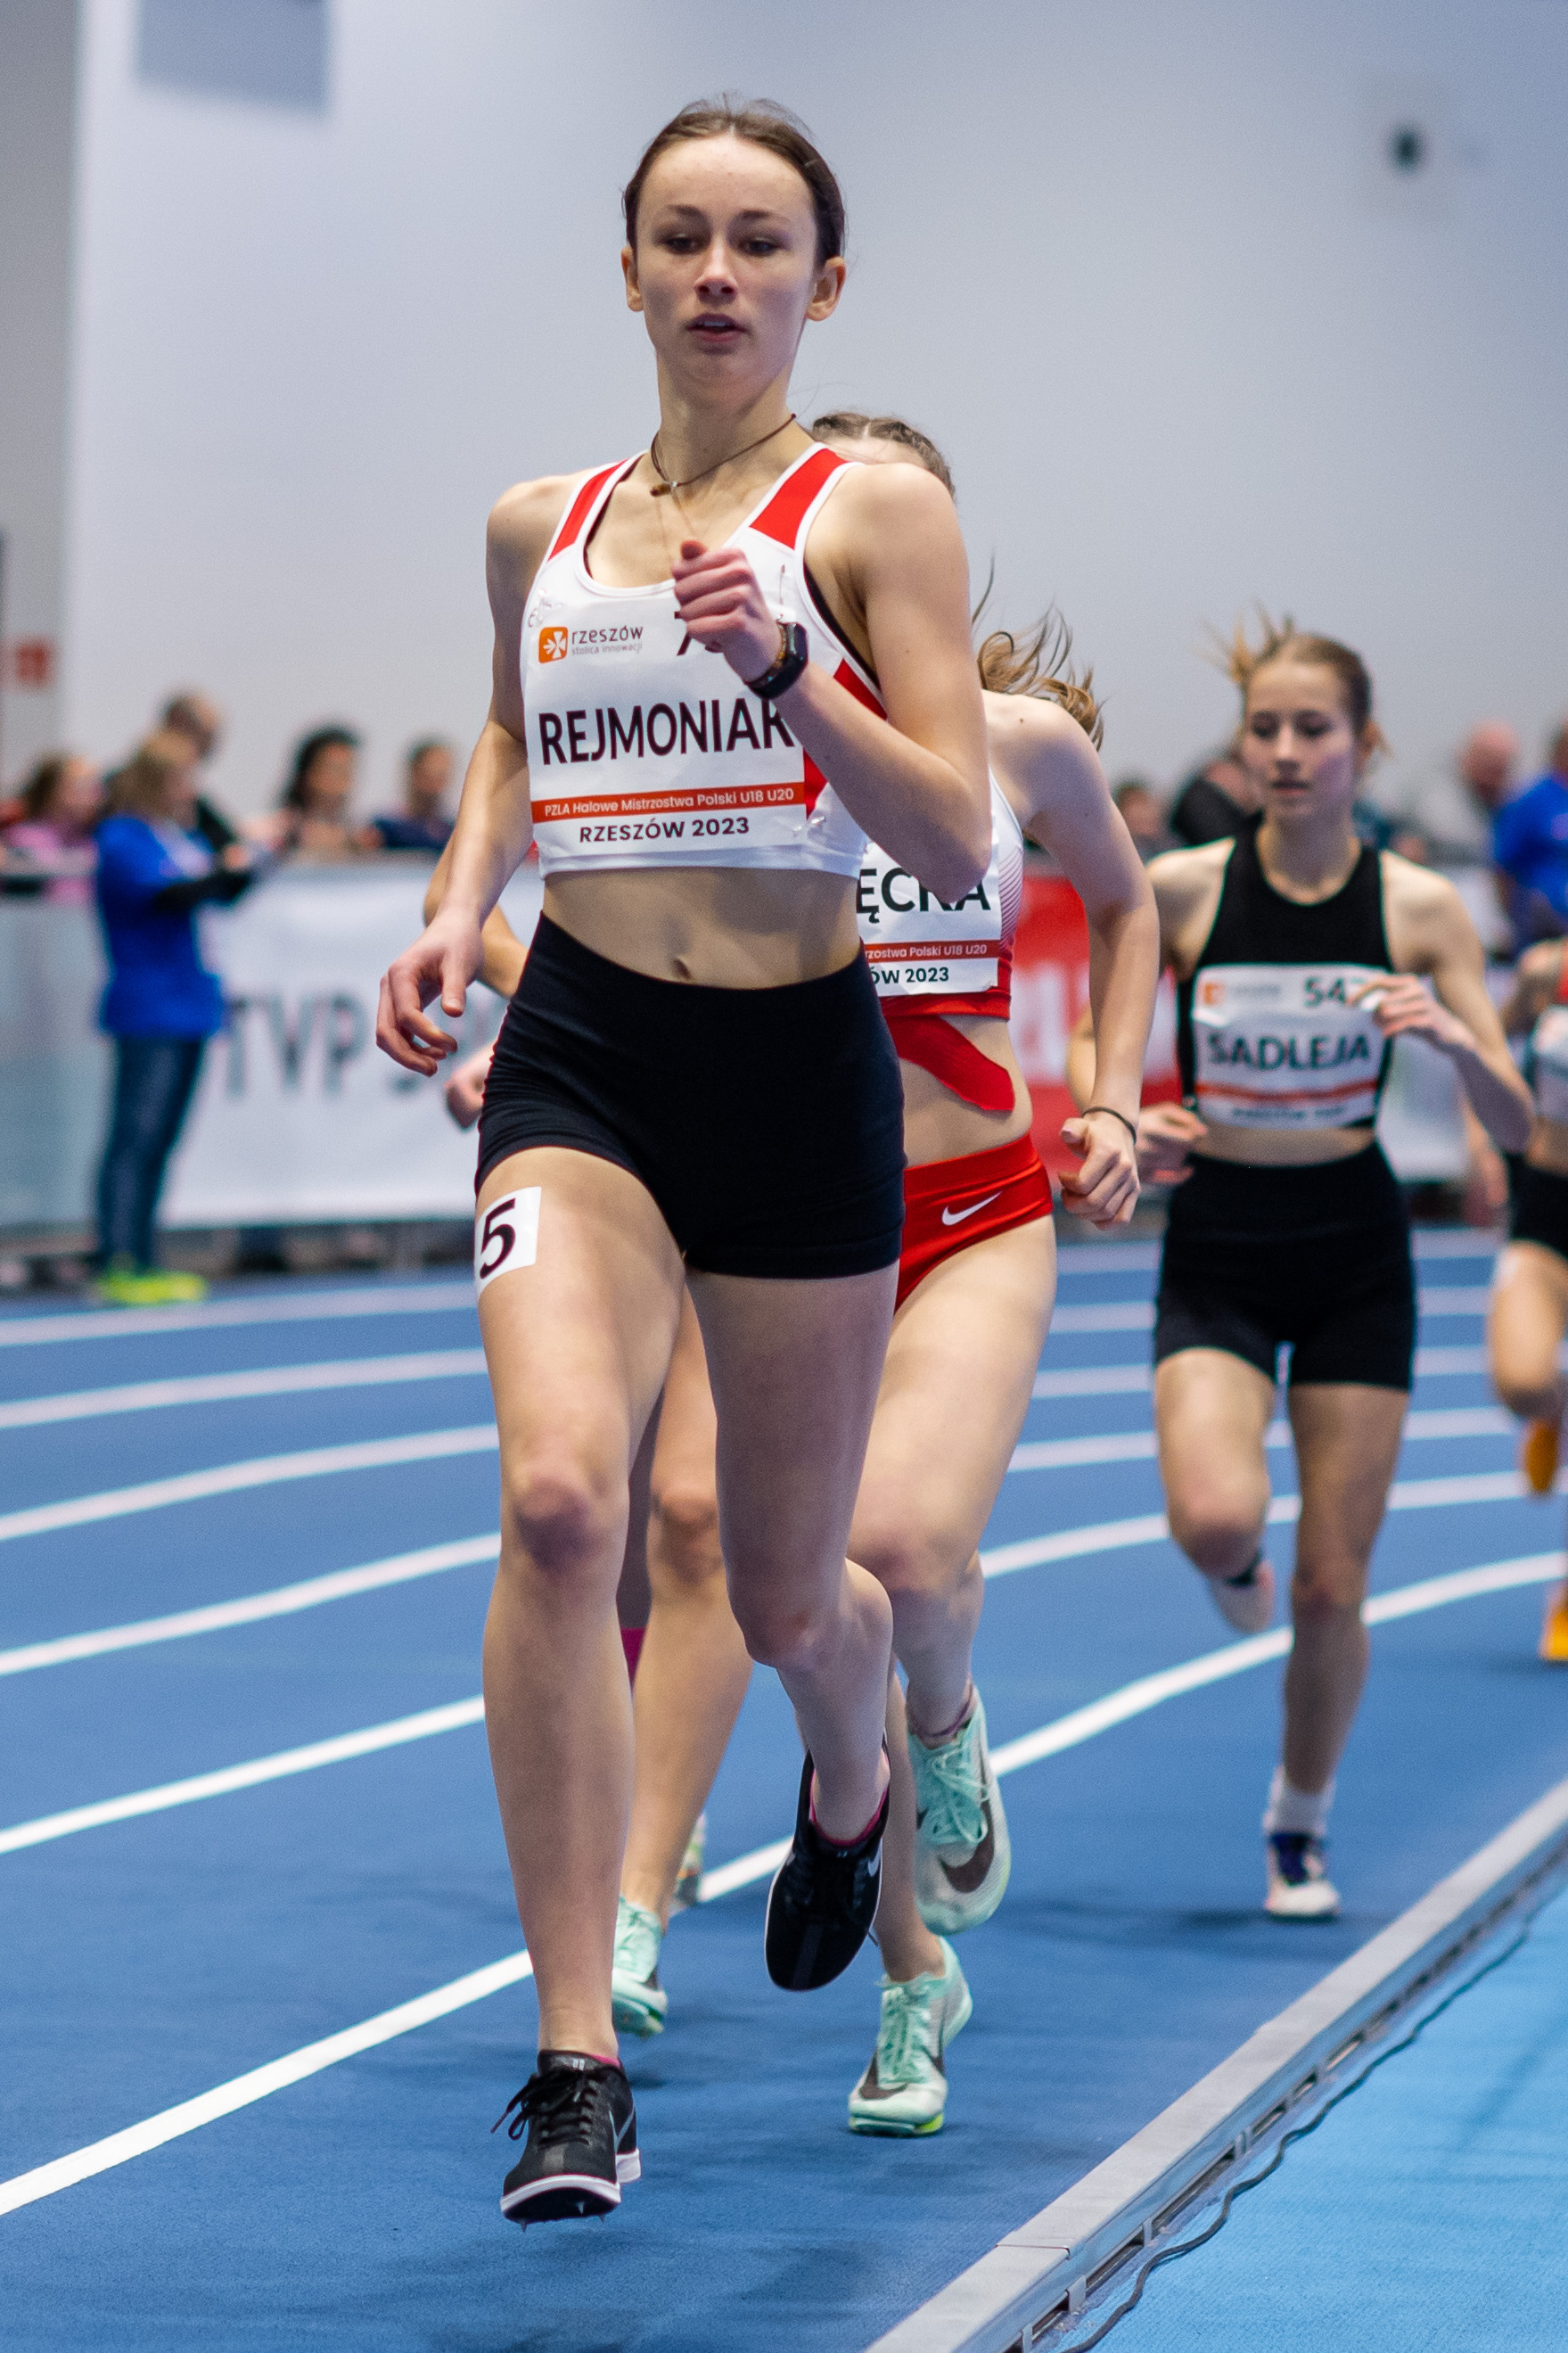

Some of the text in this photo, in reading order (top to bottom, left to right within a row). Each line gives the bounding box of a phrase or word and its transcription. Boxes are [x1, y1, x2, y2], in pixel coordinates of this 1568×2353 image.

[571, 625, 644, 645] rzeszów
[538, 697, 796, 765] REJMONIAK
[545, 788, 794, 817] PZLA Halowe Mistrzostwa Polski U18 U20
[579, 817, 750, 843] RZESZÓW 2023
[909, 946, 941, 957] Polski
[943, 945, 963, 955] U18
[965, 944, 987, 955] U20
[905, 967, 949, 983] 2023
[1209, 1033, 1370, 1071] SADLEJA
[480, 1197, 516, 1279] 5
